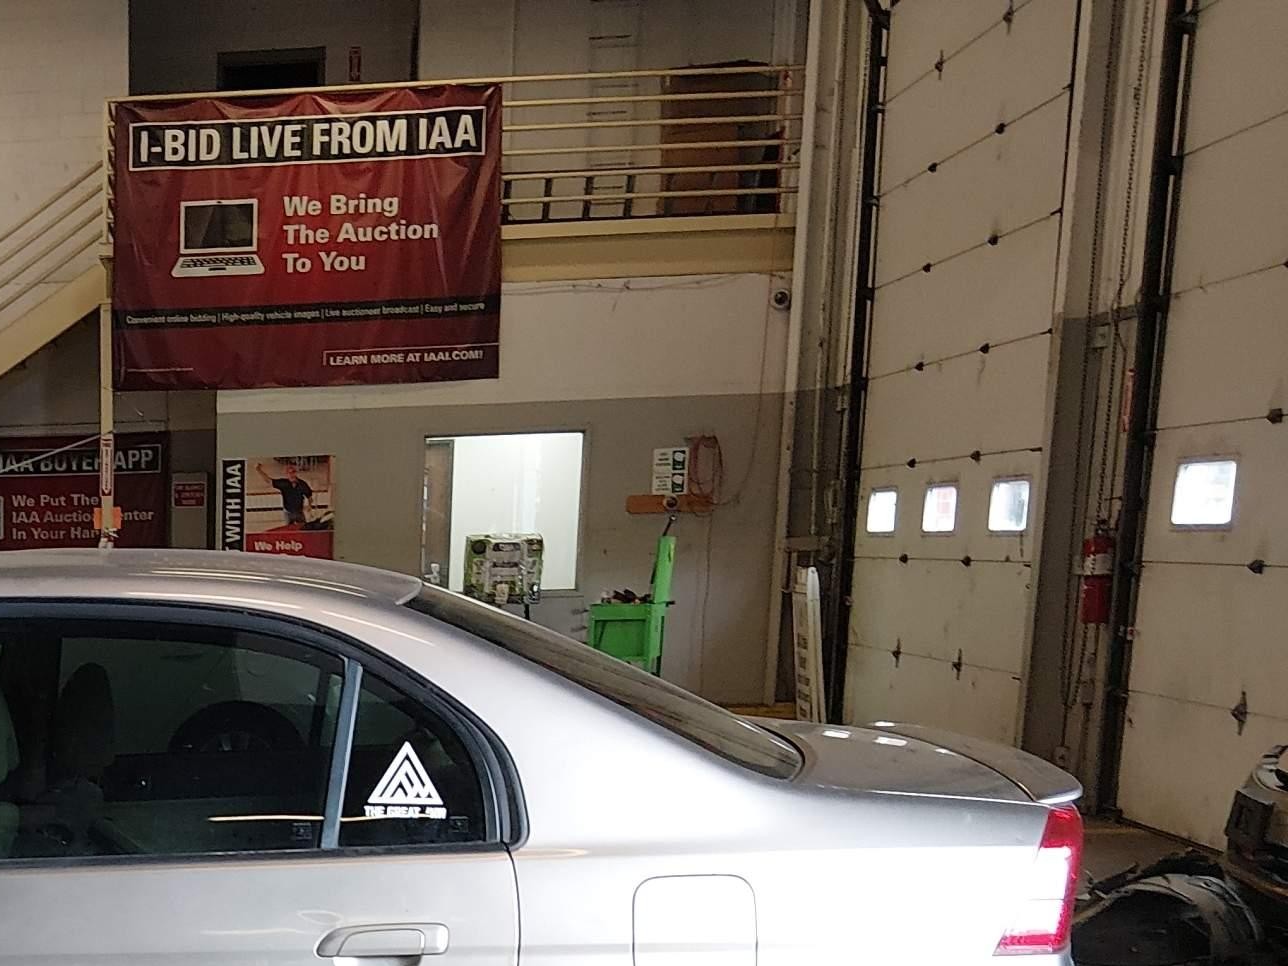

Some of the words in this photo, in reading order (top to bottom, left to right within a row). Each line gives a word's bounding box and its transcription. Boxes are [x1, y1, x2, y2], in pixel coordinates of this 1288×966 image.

[140, 129, 221, 163] I-BID
[232, 124, 303, 160] LIVE
[312, 118, 408, 156] FROM
[418, 114, 477, 150] IAA
[283, 196, 323, 217] We
[330, 193, 399, 217] Bring
[283, 224, 330, 245] The
[336, 219, 439, 243] Auction
[282, 252, 312, 274] To
[318, 251, 366, 272] You
[325, 307, 341, 318] Live
[425, 303, 442, 314] Easy
[444, 302, 458, 312] and
[330, 355, 368, 366] LEARN
[370, 352, 404, 364] MORE
[406, 352, 421, 362] AT
[114, 449, 153, 470] APP
[225, 463, 242, 494] IAA
[12, 494, 35, 508] We
[40, 494, 66, 507] Put
[70, 493, 99, 506] The
[12, 511, 41, 524] IAA
[46, 510, 94, 523] Auctio
[225, 497, 241, 544] WITH
[12, 529, 27, 540] In
[31, 528, 65, 540] Your
[254, 540, 273, 551] We
[275, 540, 303, 552] Help
[364, 805, 386, 819] THE
